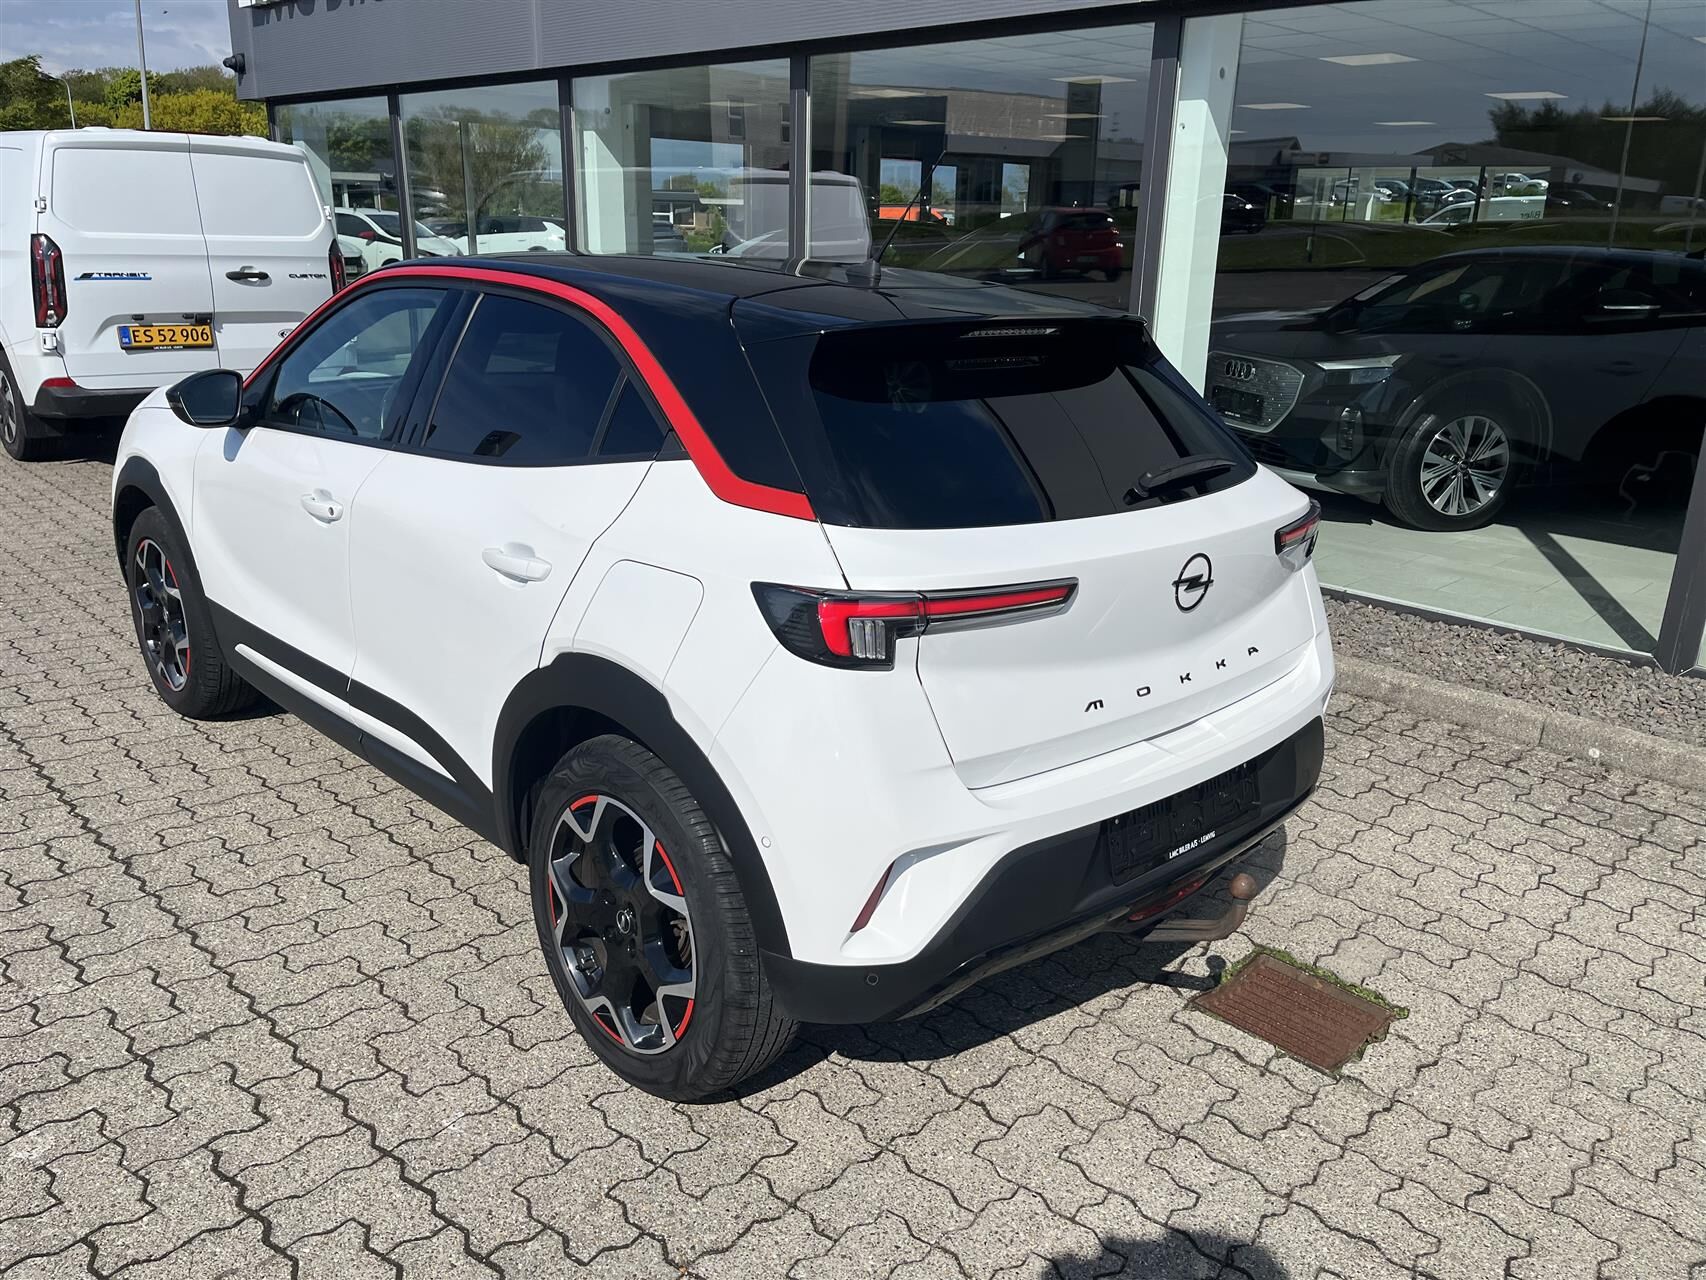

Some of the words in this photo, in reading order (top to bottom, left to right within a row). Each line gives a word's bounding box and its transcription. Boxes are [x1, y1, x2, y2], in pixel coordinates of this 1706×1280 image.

[132, 329, 154, 343] ES
[157, 329, 177, 343] 52
[180, 327, 209, 342] 906
[1084, 646, 1259, 713] MOKKA
[1169, 849, 1179, 859] LMC
[1179, 843, 1190, 854] BILER
